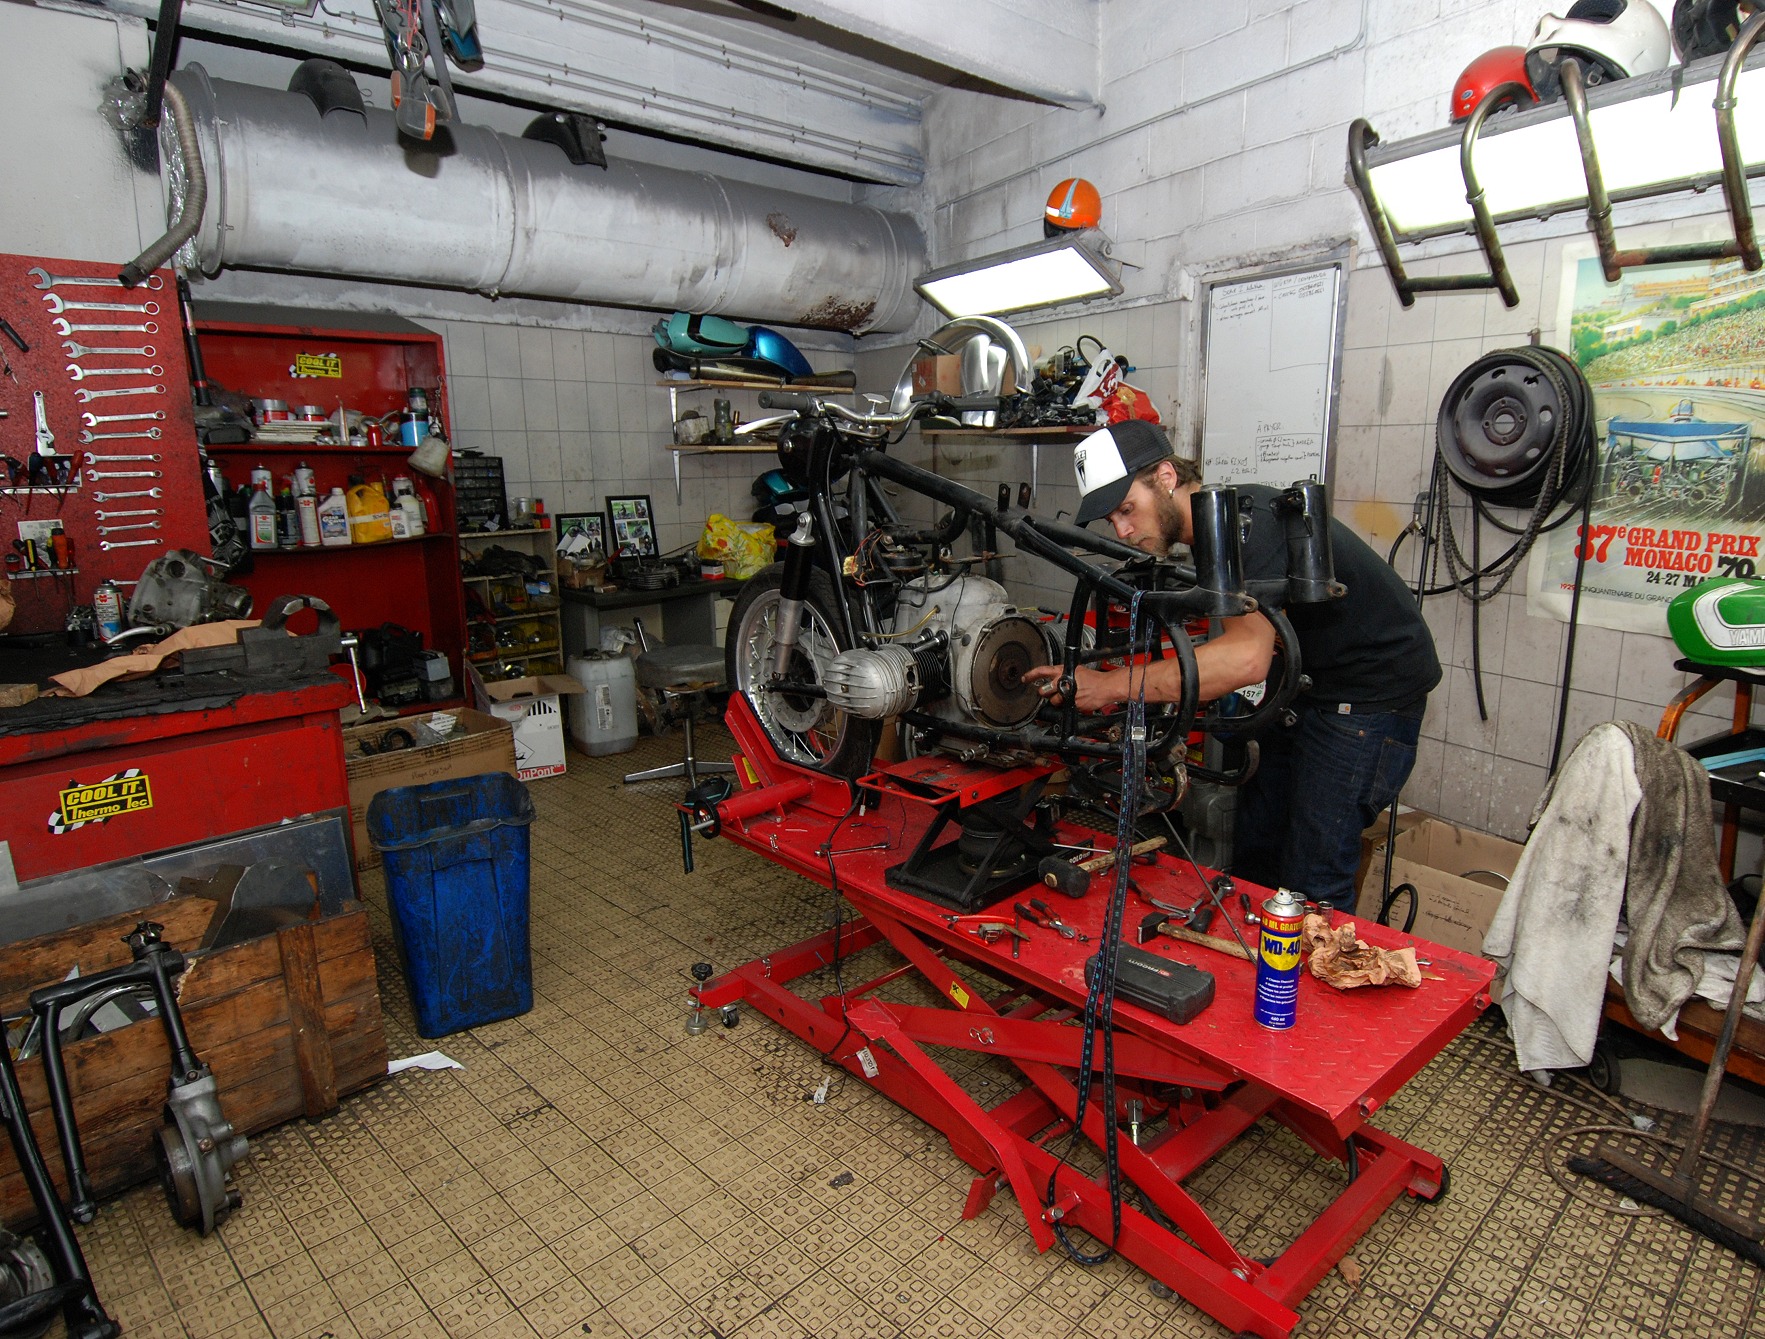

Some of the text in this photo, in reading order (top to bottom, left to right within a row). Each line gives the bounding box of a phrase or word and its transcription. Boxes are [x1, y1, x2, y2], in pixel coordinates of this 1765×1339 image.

[299, 357, 337, 367] COOL IT
[1627, 527, 1702, 551] GRAND
[1704, 532, 1761, 557] PRIX
[1623, 547, 1713, 574] MONACO
[1646, 571, 1712, 587] 24-27 MA
[1580, 585, 1633, 599] CINQUANTENAIRE
[1646, 594, 1673, 604] GRAND
[66, 780, 140, 806] COOL IT
[66, 796, 148, 820] Thermo Tec
[1263, 935, 1301, 956] WD-40
